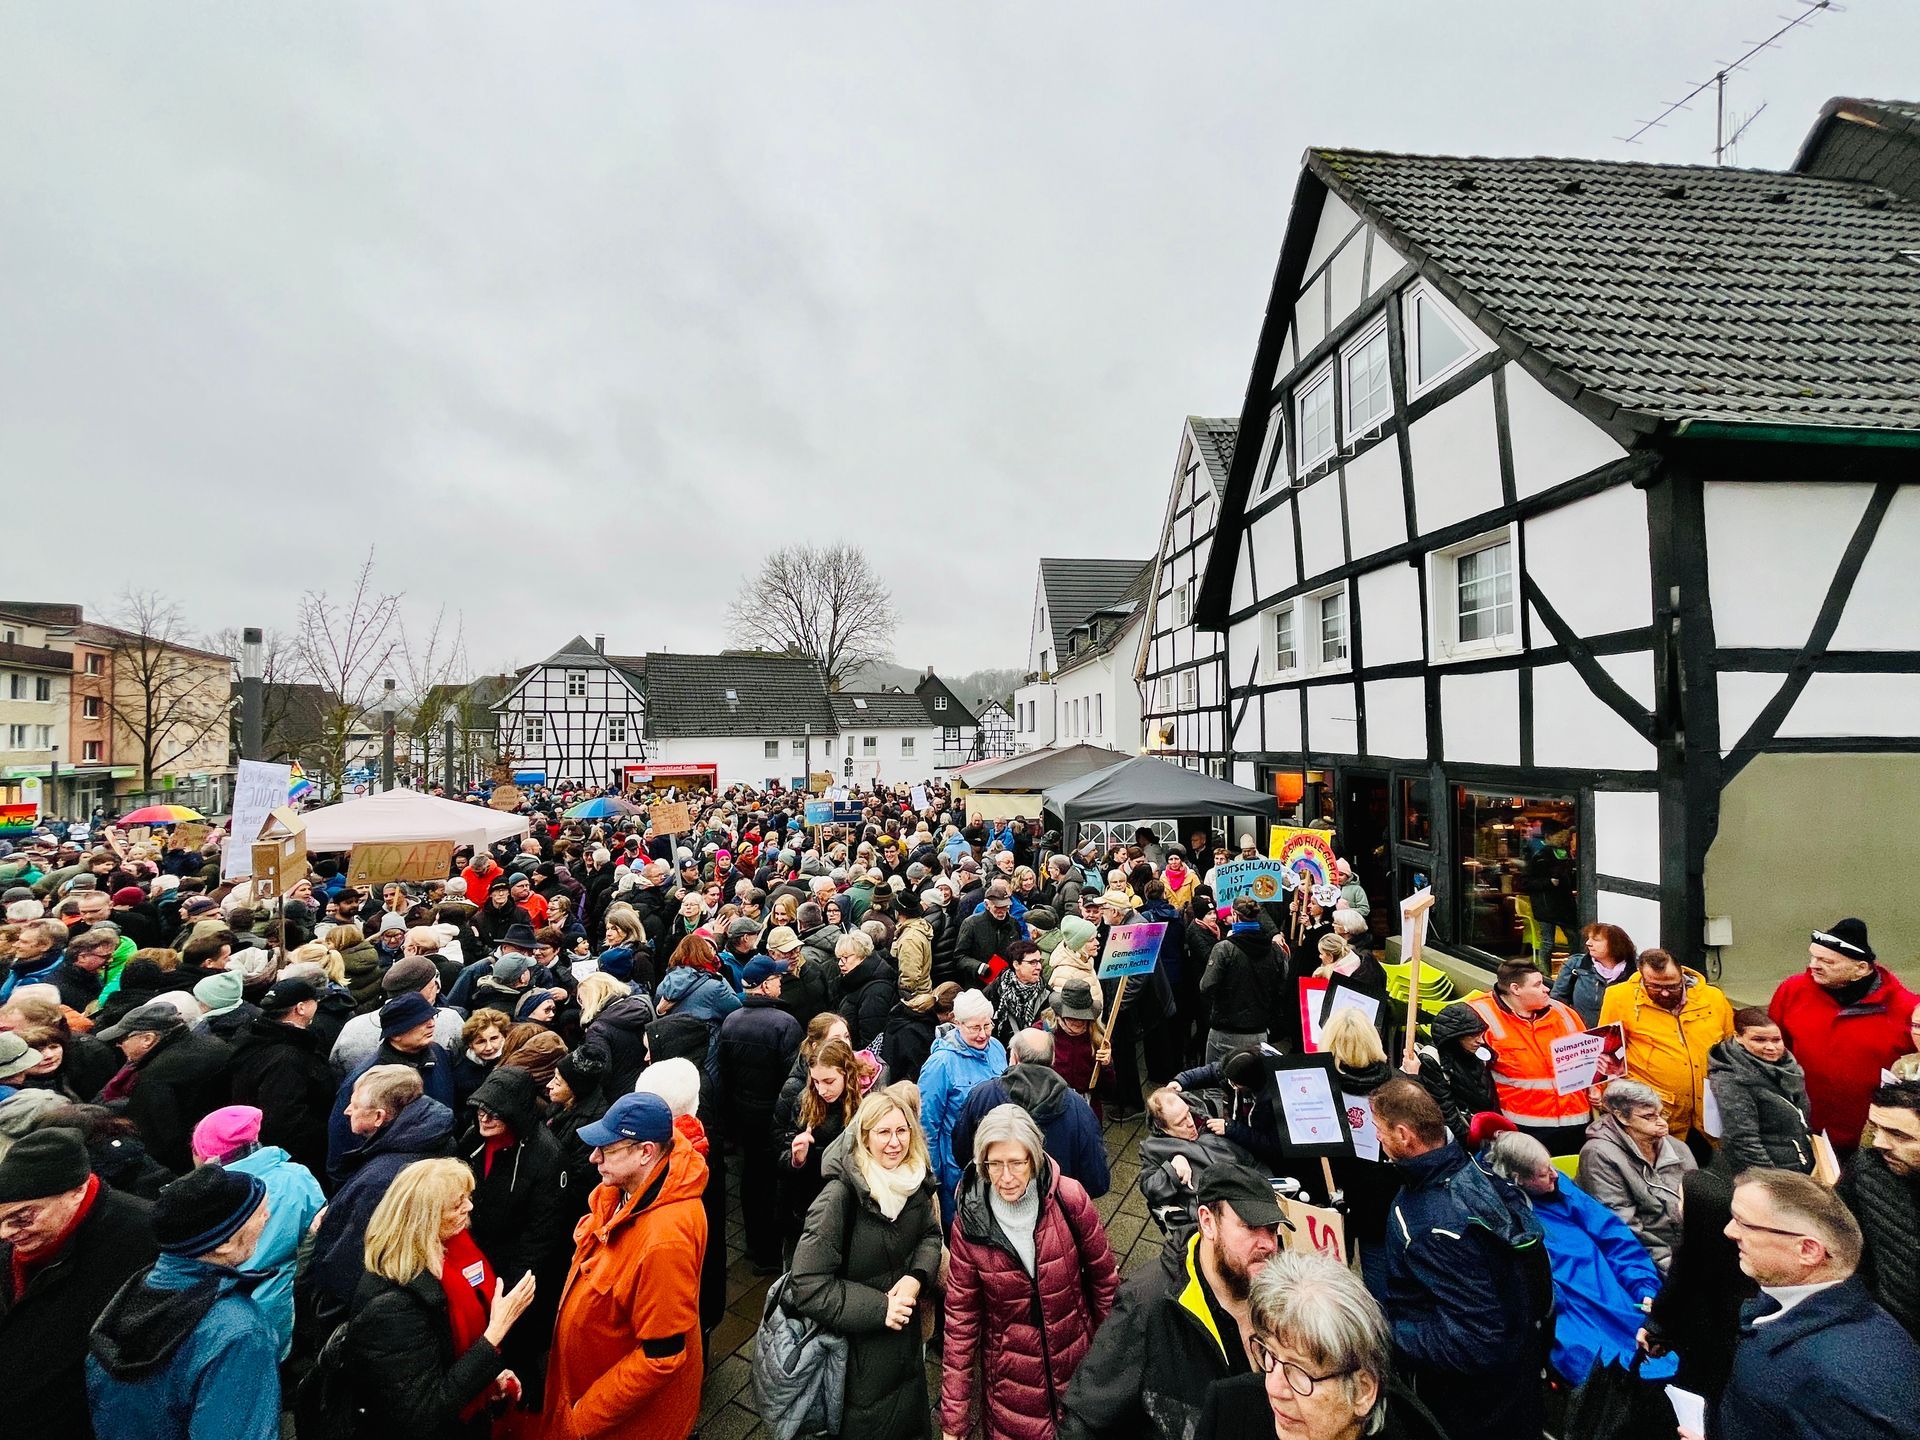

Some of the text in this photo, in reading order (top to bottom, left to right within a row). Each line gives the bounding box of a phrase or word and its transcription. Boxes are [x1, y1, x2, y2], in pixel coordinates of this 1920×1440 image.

[1304, 836, 1325, 853] ALLE
[1217, 861, 1281, 877] DEUTSCHLAND
[1230, 875, 1245, 884] IST
[1111, 948, 1151, 958] Gemeinsam
[1105, 959, 1150, 972] gegen Rechts
[1554, 1037, 1599, 1054] Volmarstein
[1555, 1045, 1600, 1064] gegen Hass!
